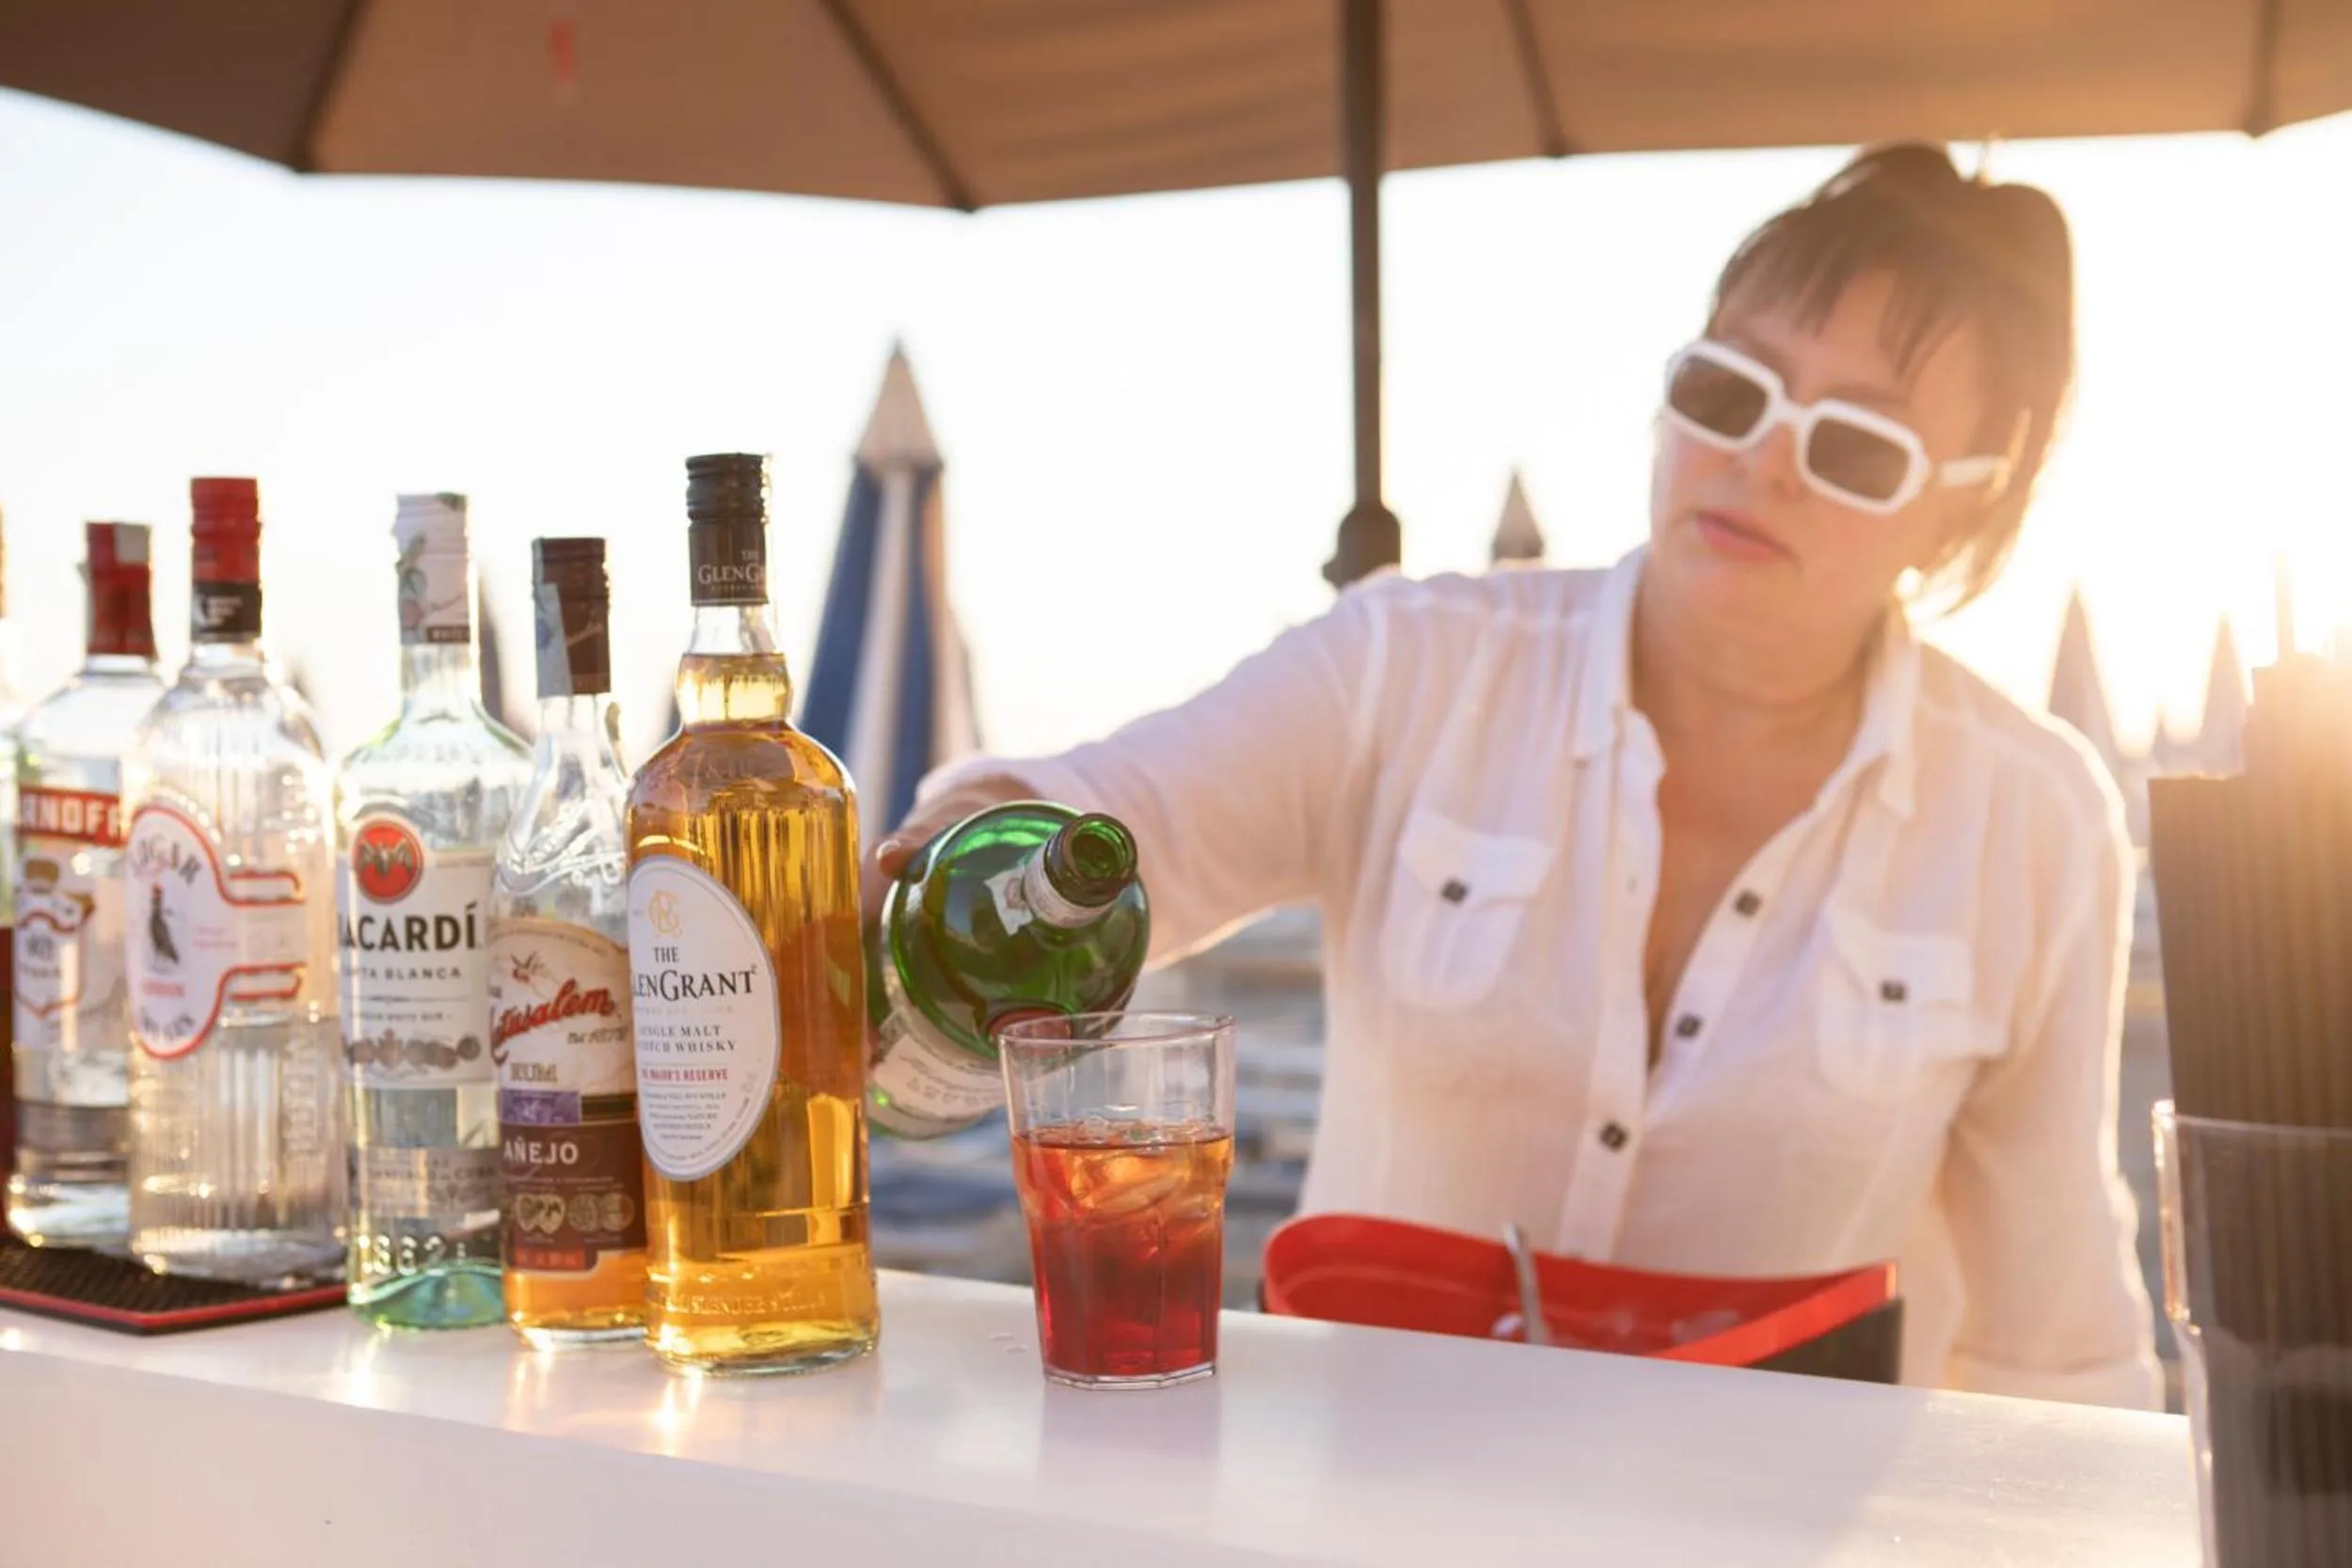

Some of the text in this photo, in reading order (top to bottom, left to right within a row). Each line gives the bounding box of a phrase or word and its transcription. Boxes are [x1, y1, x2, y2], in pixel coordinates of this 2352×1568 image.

[698, 562, 764, 585] GLENG
[19, 793, 121, 838] RNOFF
[339, 902, 476, 952] ACARDÍ
[653, 946, 678, 963] THE
[385, 967, 461, 980] BLANCA
[633, 969, 753, 1002] LENGRANT
[680, 1023, 722, 1037] MALT
[675, 1038, 736, 1053] WHISKY
[503, 1136, 579, 1165] AÑEJO
